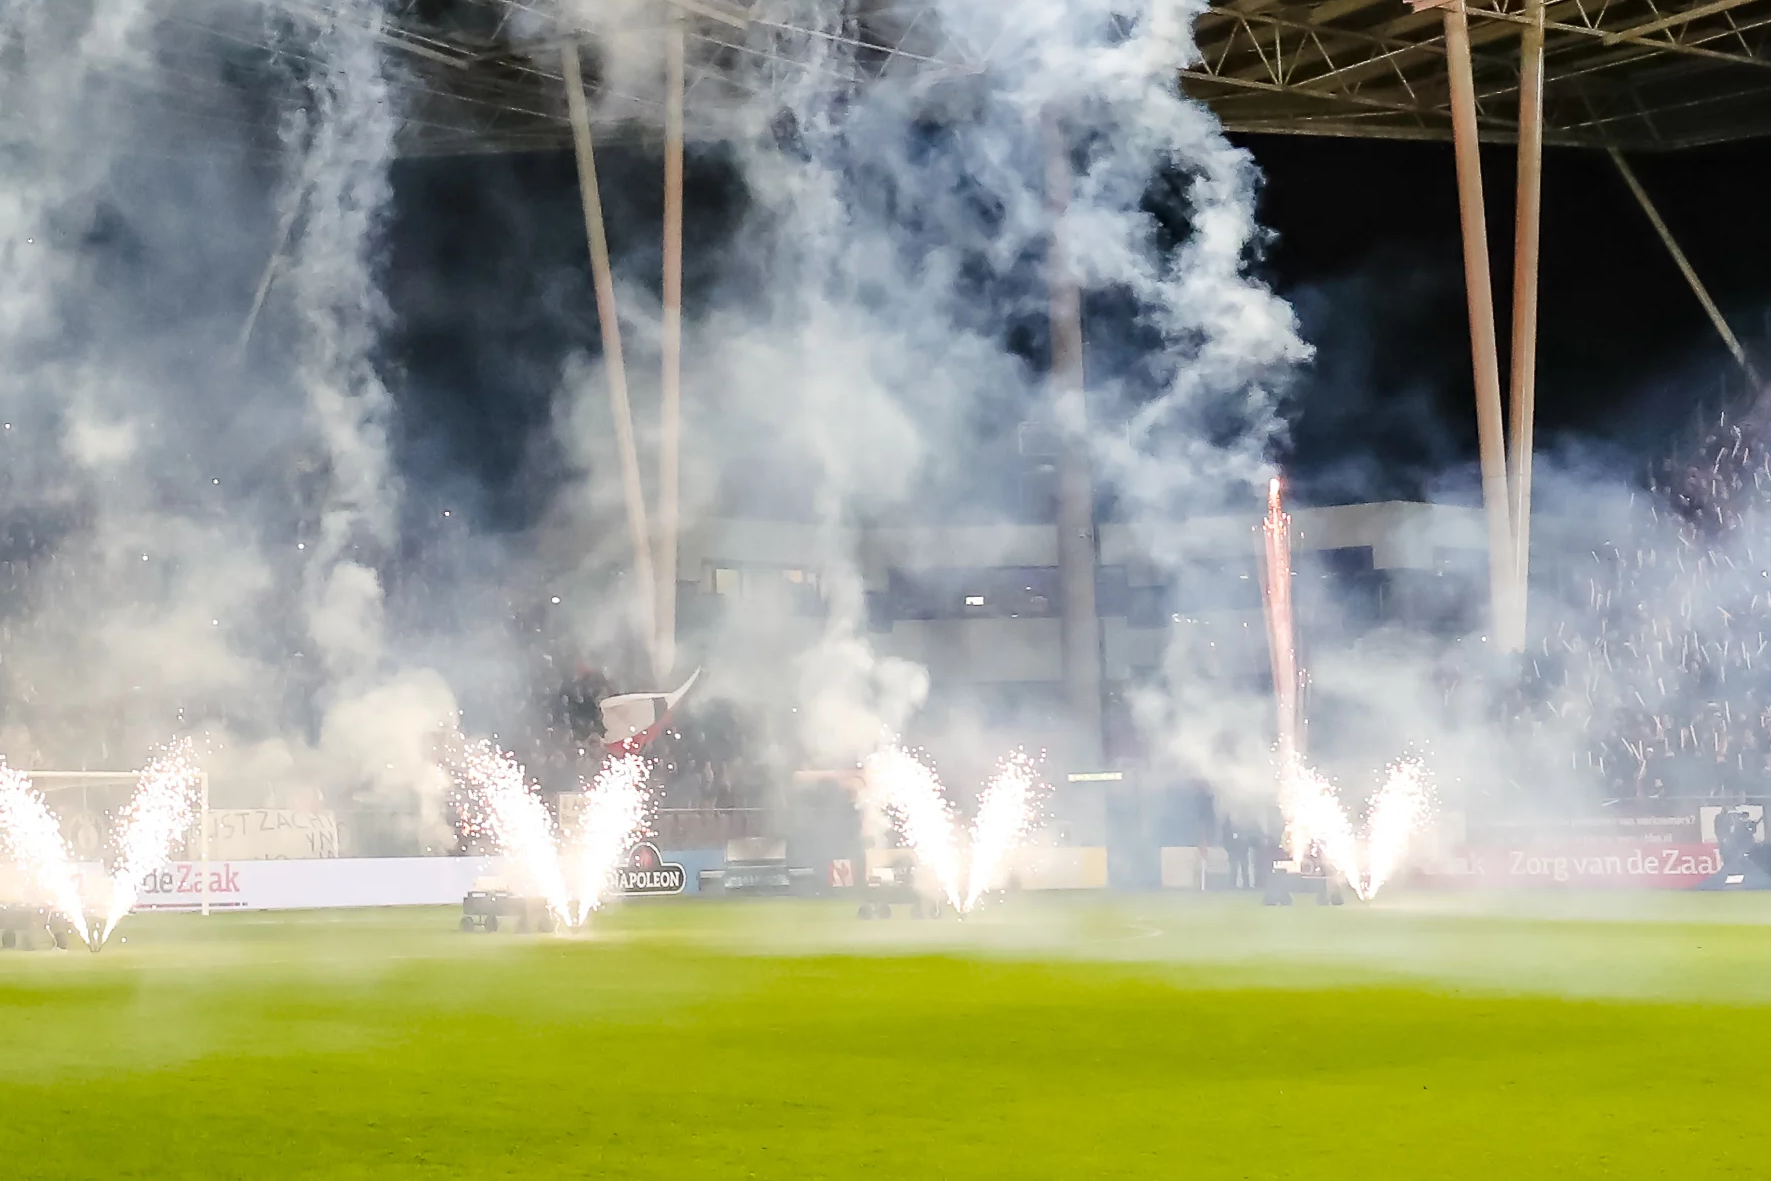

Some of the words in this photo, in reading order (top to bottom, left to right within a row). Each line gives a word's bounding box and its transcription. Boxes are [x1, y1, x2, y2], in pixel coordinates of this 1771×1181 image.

[1509, 850, 1570, 882] Zorg
[1573, 856, 1622, 875] van
[1628, 849, 1659, 875] de
